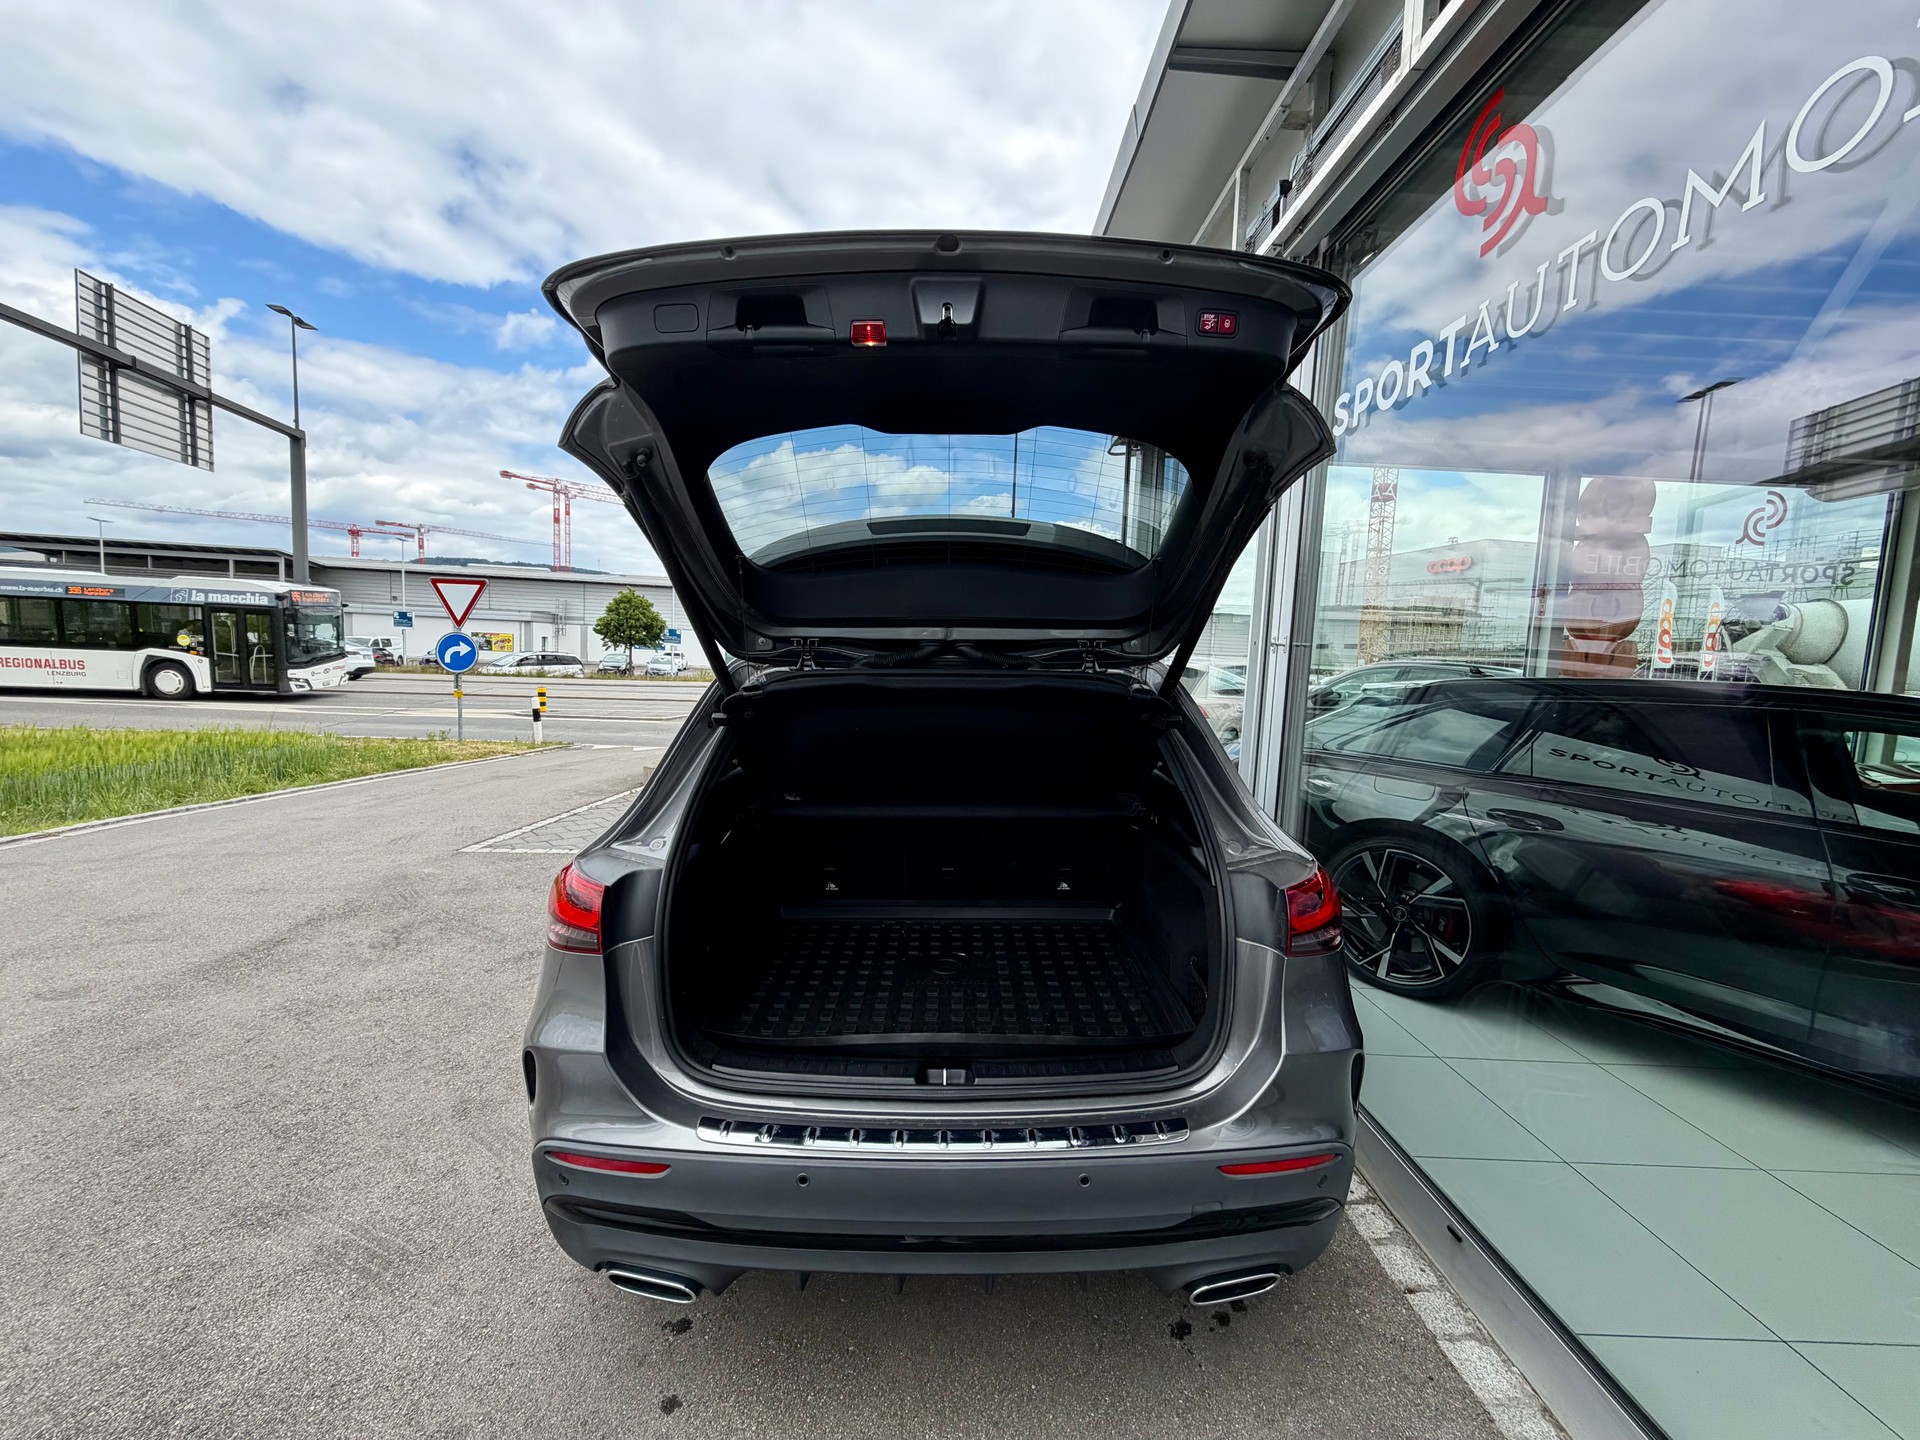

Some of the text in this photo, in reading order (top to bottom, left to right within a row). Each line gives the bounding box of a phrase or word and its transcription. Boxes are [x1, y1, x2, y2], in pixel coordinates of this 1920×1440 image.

[1332, 18, 1920, 437] SPORTAUTOMO
[1426, 556, 1473, 575] coop
[191, 590, 269, 605] la macchia
